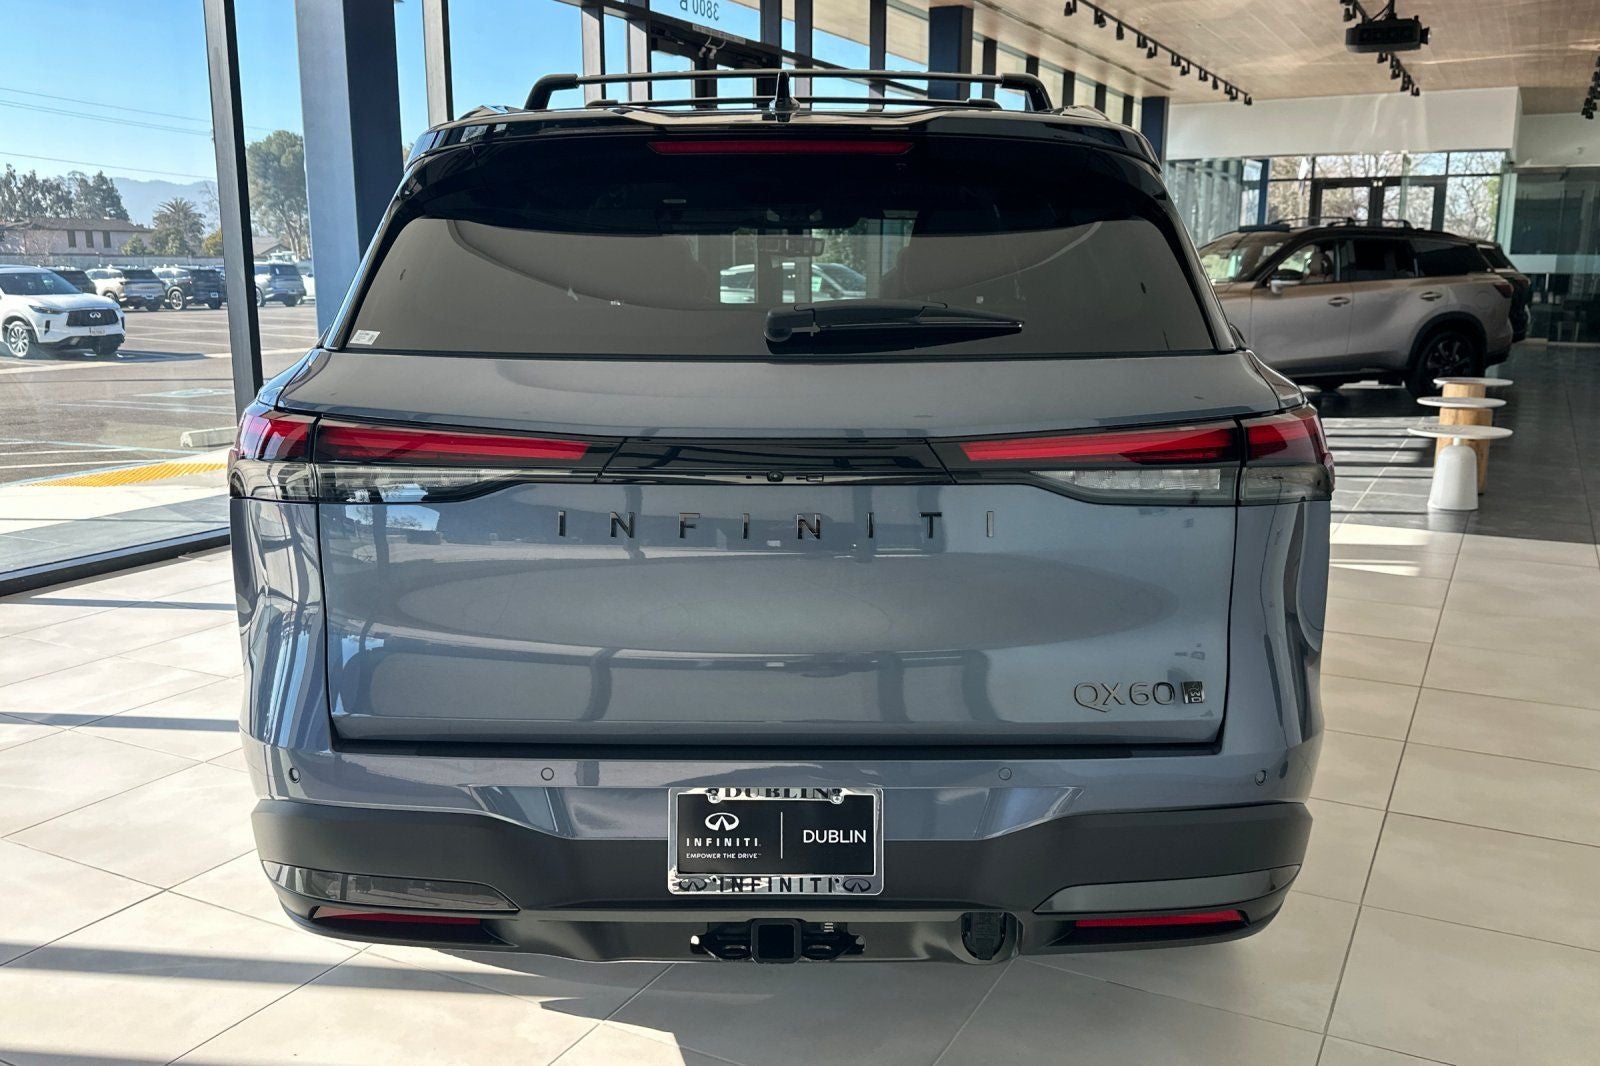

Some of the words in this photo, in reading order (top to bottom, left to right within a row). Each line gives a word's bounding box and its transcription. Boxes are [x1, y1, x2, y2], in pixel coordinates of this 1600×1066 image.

[558, 511, 995, 540] INFINITI
[1073, 681, 1175, 713] QX60
[725, 788, 829, 799] DUBLIN
[686, 837, 758, 847] INFINITI
[803, 829, 867, 844] DUBLIN
[719, 877, 834, 893] INFINITI
